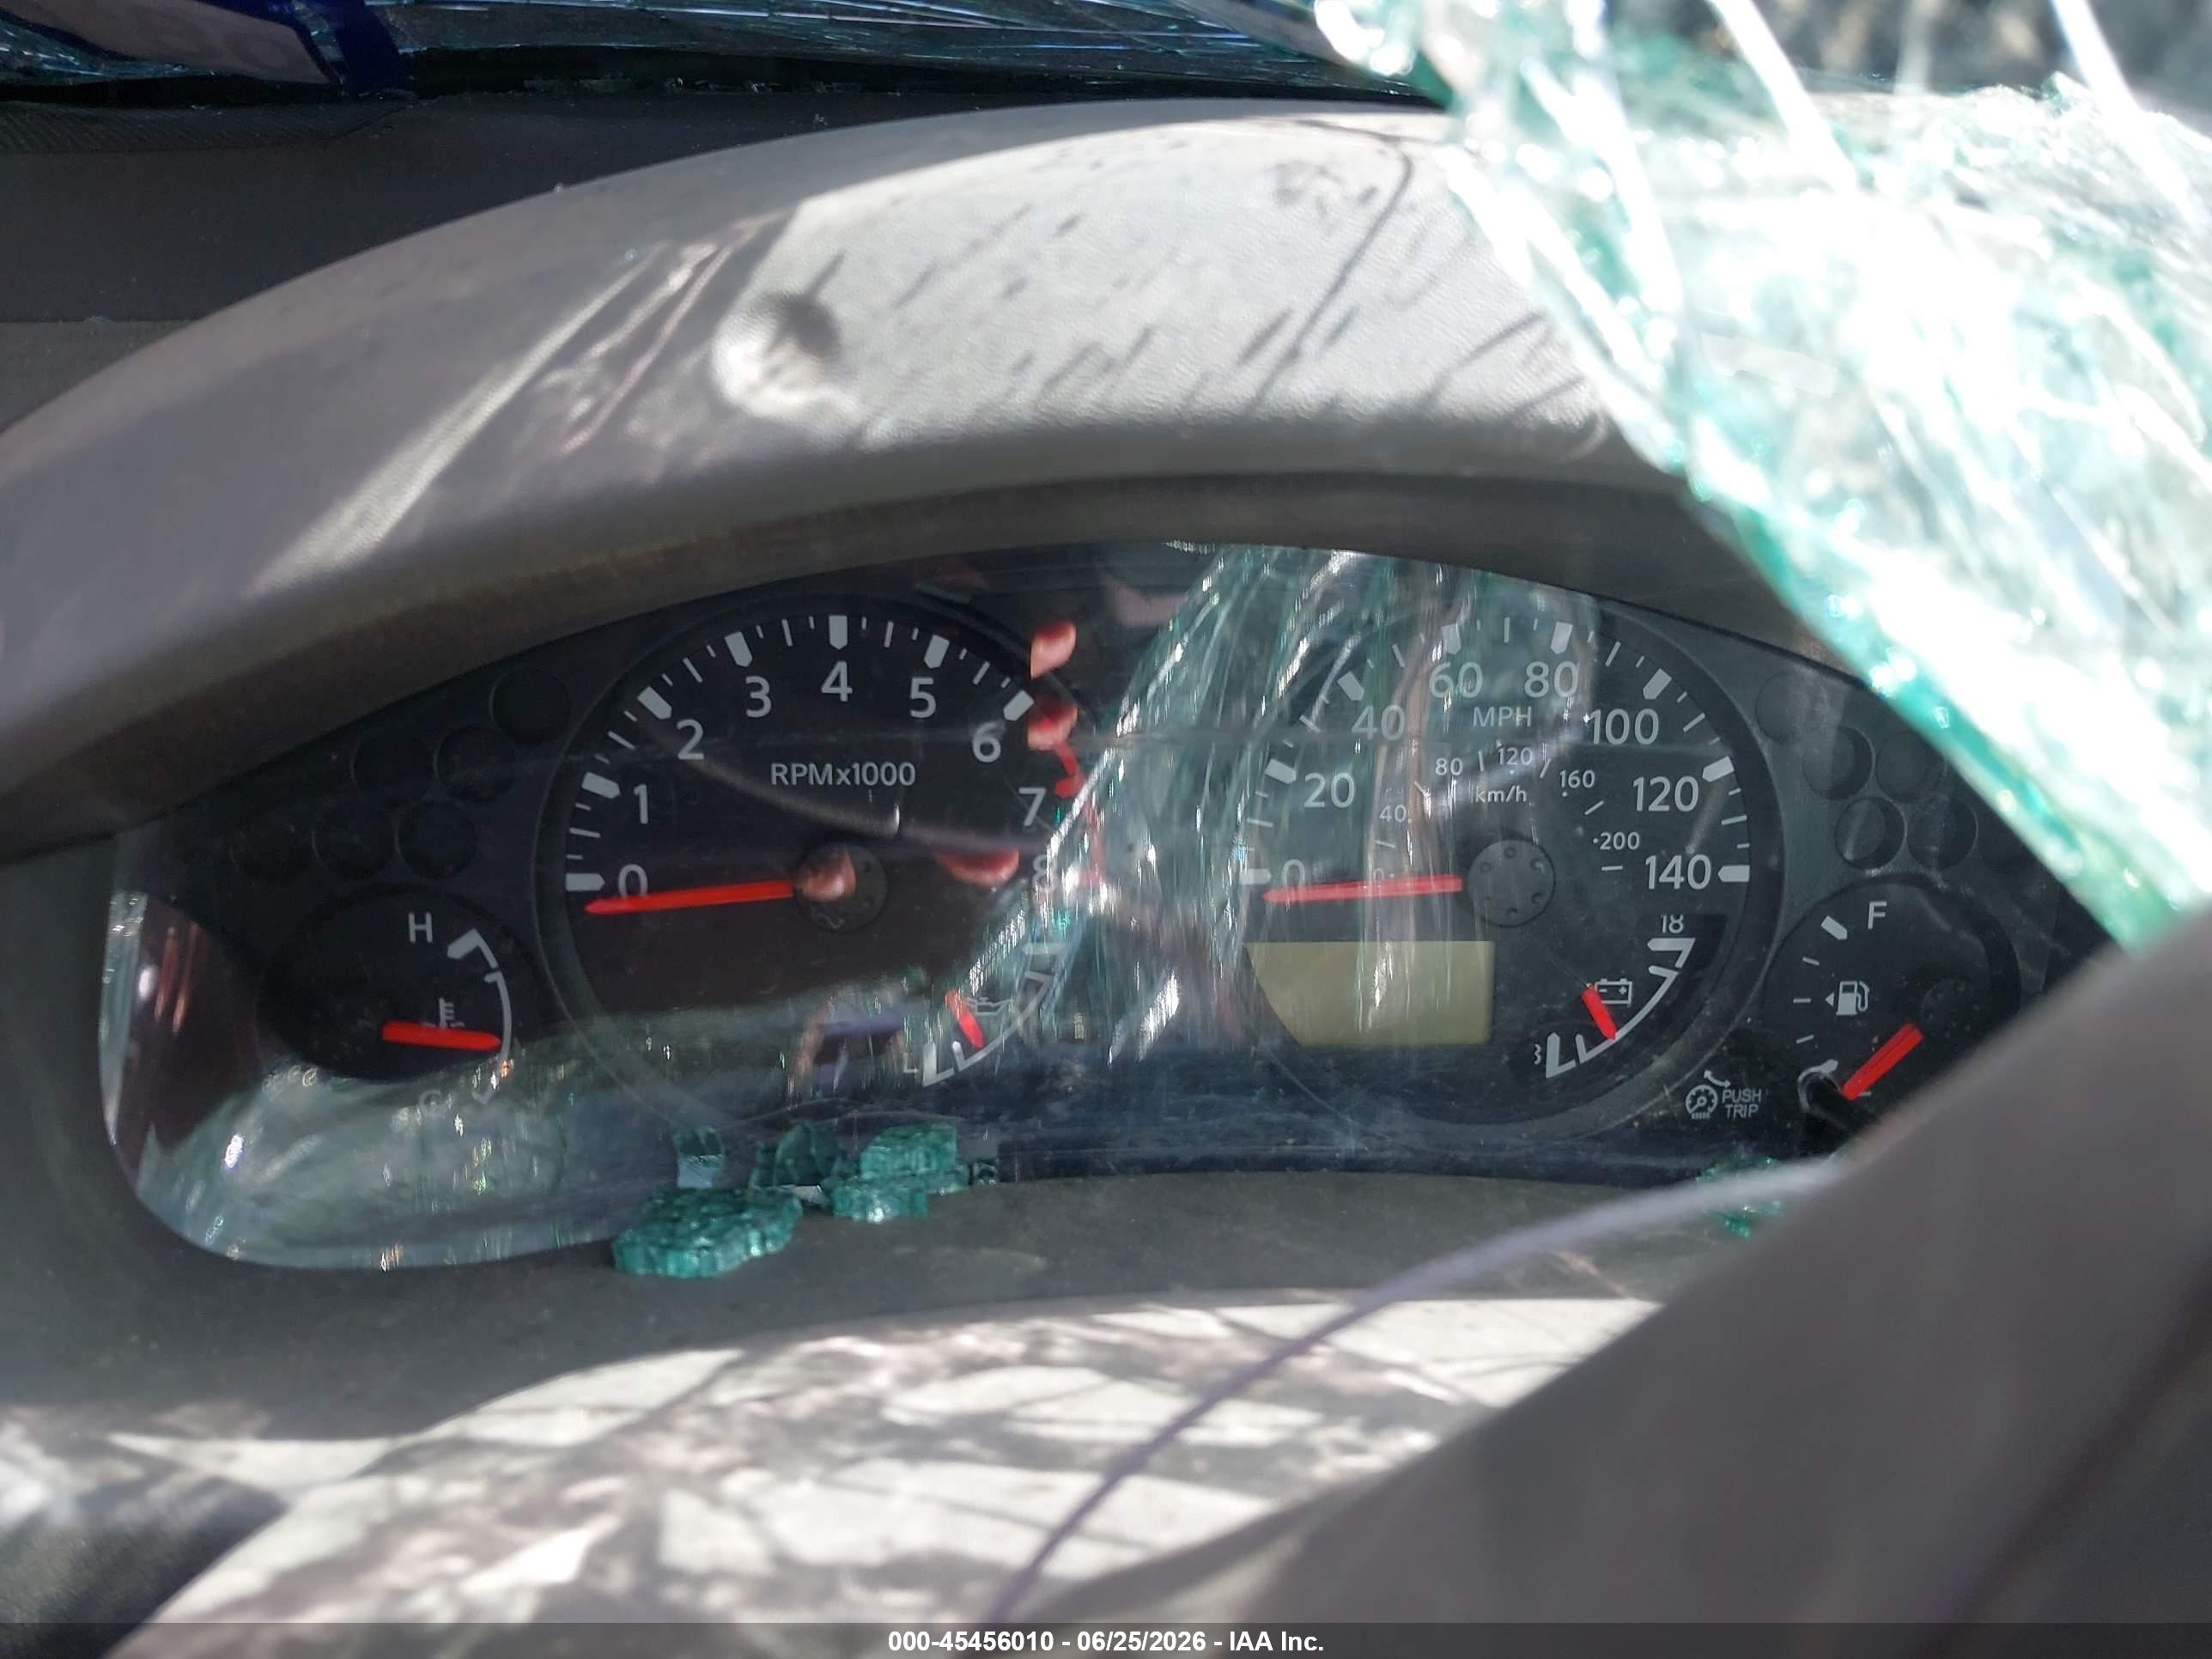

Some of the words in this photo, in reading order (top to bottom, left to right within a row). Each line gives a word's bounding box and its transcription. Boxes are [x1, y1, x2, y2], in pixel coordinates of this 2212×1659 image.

[821, 661, 853, 702] 4
[1429, 661, 1483, 698] 60
[1524, 661, 1579, 698] 80
[745, 677, 772, 718] 3
[909, 678, 936, 718] 5
[1352, 705, 1406, 741] 40
[1473, 707, 1533, 728] MPH
[1589, 709, 1660, 745] 100
[676, 719, 705, 760] 2
[972, 721, 1001, 763] 6
[1498, 747, 1533, 767] 120
[771, 763, 916, 787] RPMx1000
[1435, 758, 1463, 776] 80
[1559, 770, 1595, 789] 160
[633, 785, 649, 824] 1
[1018, 787, 1047, 826] 7
[1304, 774, 1355, 809] 20
[1476, 785, 1528, 805] km/h
[1632, 776, 1699, 813] 120
[1379, 805, 1407, 824] 40
[1600, 832, 1639, 851] 200
[617, 864, 648, 900] 0
[1282, 859, 1306, 891] 0
[1644, 854, 1711, 890] 140
[408, 911, 433, 943] H
[1661, 913, 1684, 933] 18
[1868, 901, 1887, 929] F
[1722, 1089, 1762, 1104] PUSH
[1725, 1103, 1759, 1119] TRIP
